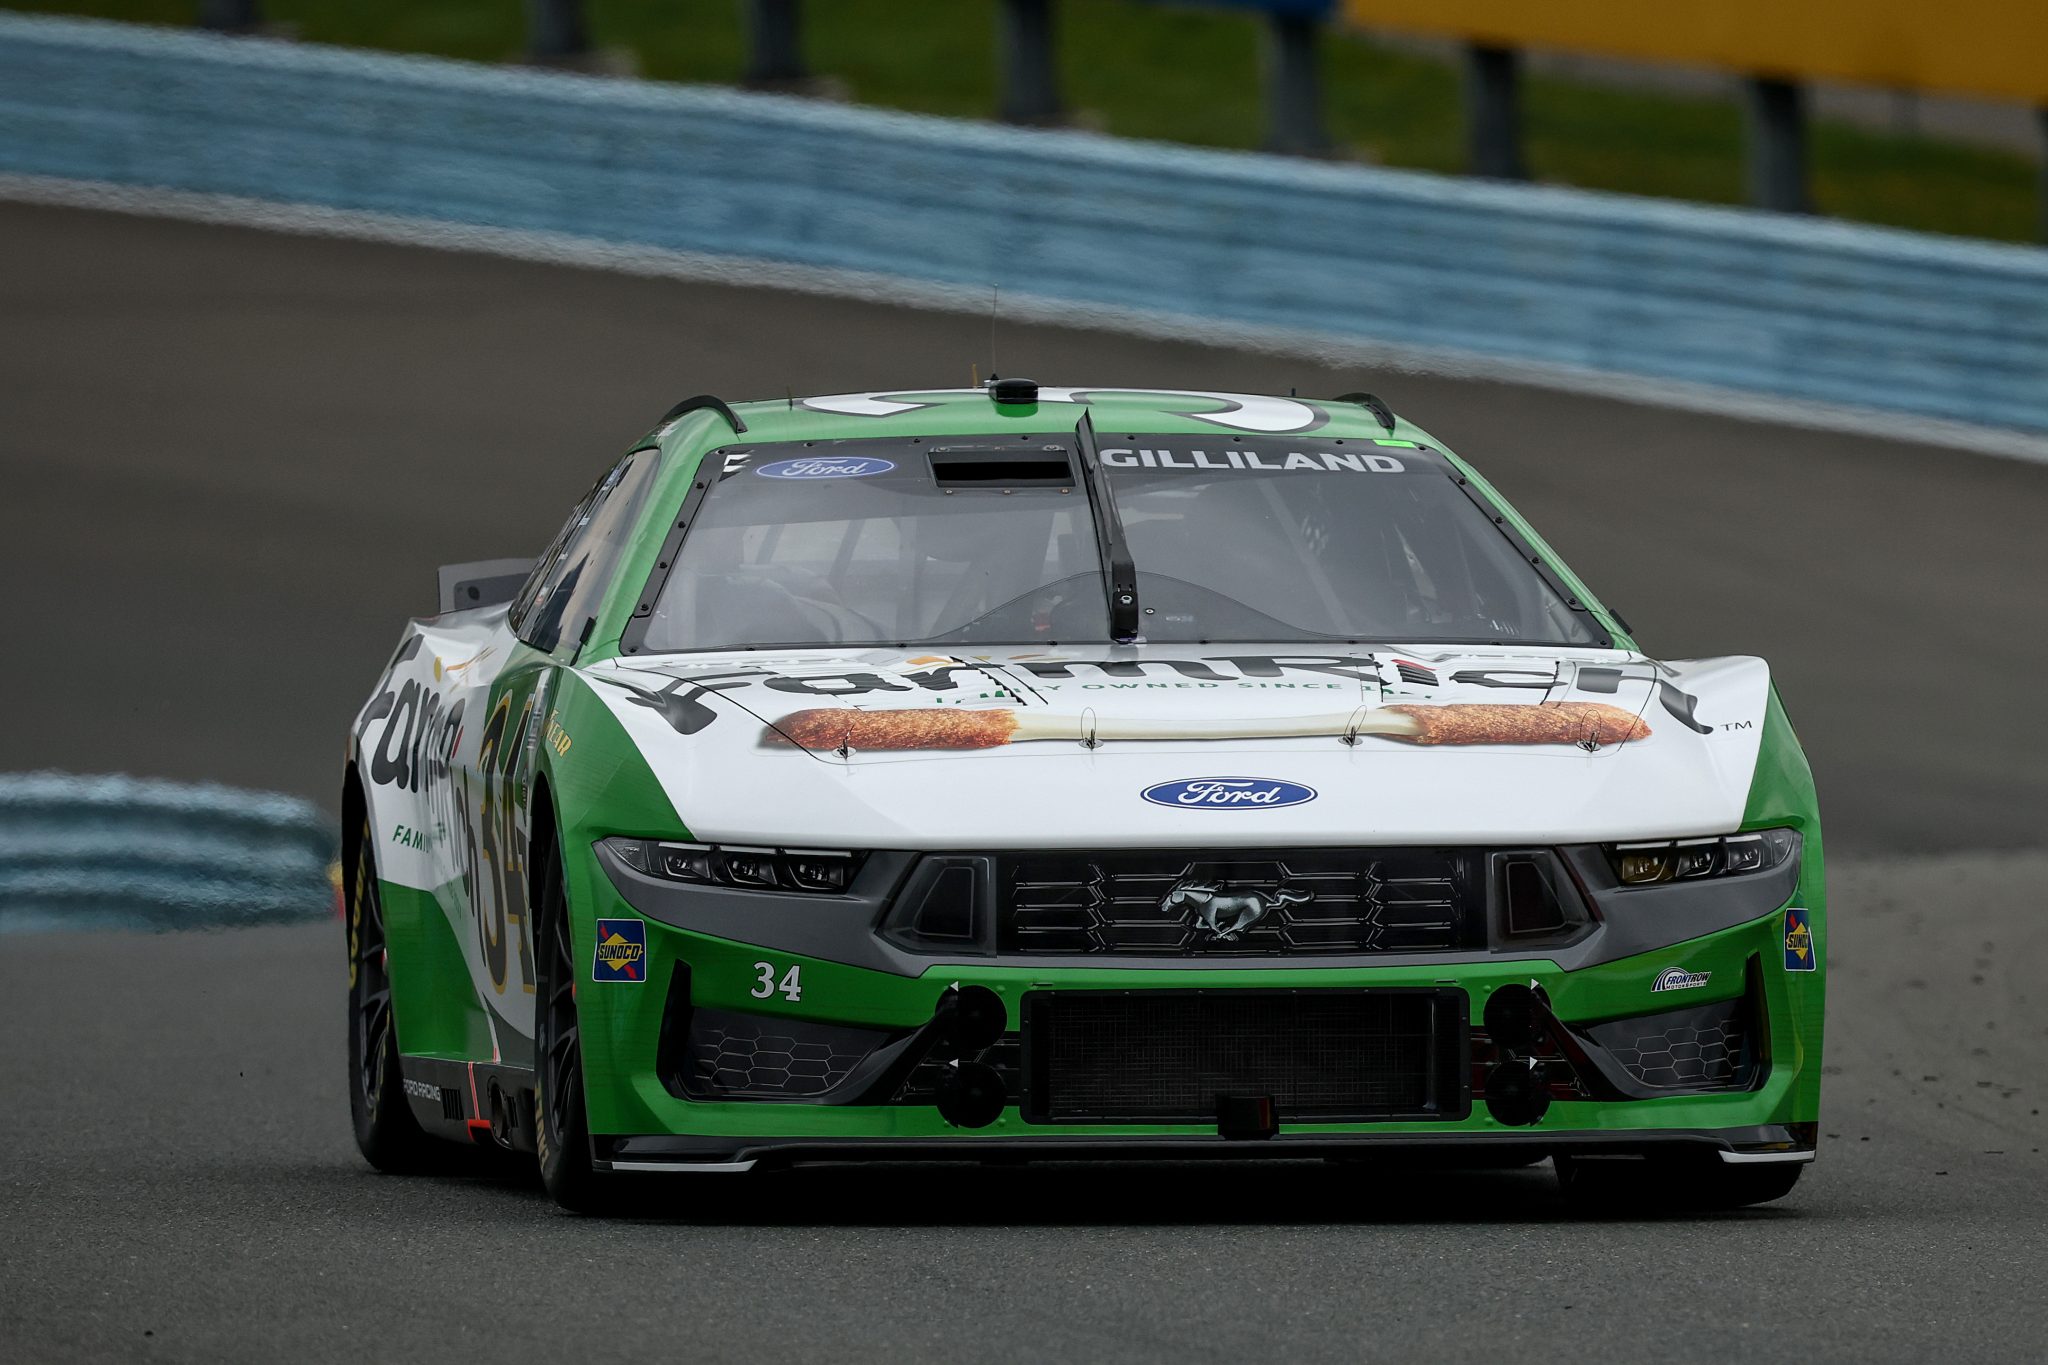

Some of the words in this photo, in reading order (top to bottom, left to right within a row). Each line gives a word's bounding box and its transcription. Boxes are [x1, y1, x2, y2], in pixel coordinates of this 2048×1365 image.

[782, 459, 867, 477] Ford
[1100, 449, 1405, 473] GILLILAND
[1238, 682, 1343, 690] SINCE
[1177, 781, 1282, 804] Ford
[599, 944, 641, 960] SUNOCO
[751, 962, 802, 1002] 34
